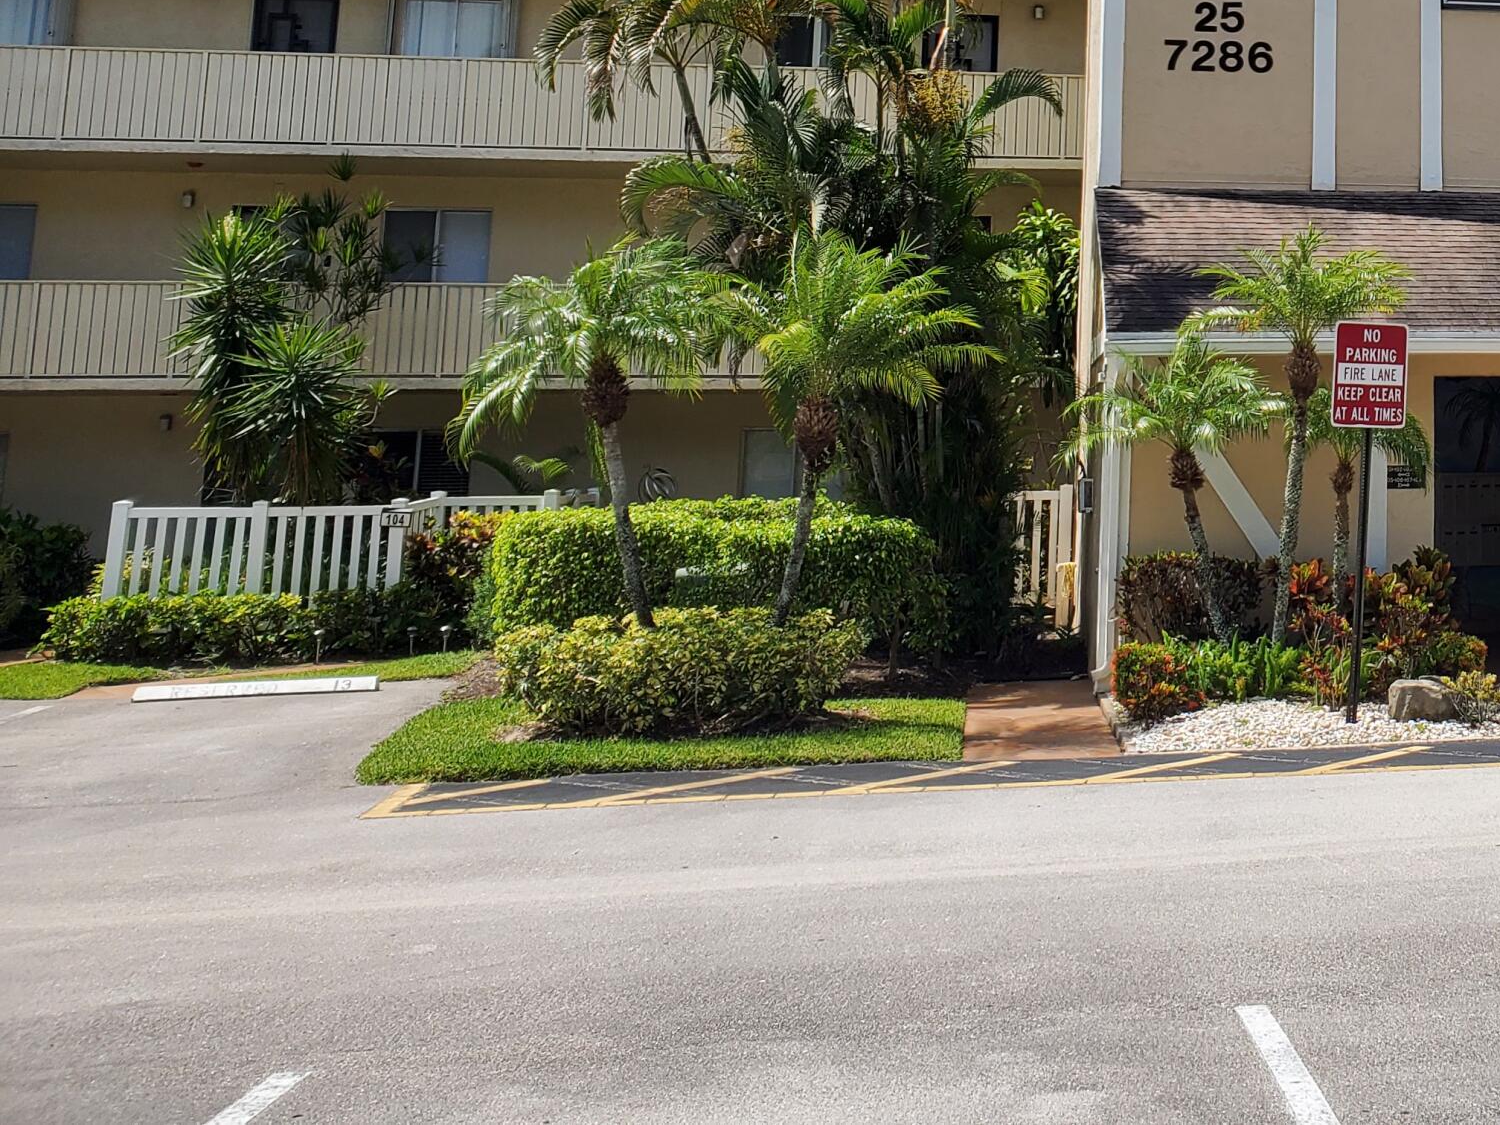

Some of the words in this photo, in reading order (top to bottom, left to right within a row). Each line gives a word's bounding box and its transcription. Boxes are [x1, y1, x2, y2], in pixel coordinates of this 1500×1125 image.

[1194, 1, 1245, 33] 25
[1164, 39, 1273, 73] 7286
[1363, 328, 1381, 343] NO
[1346, 347, 1397, 363] PARKING
[1344, 367, 1366, 381] FIRE
[1371, 368, 1397, 382] LANE
[1337, 386, 1364, 401] KEEP
[1369, 387, 1402, 402] CLEAR
[1334, 406, 1347, 421] AT
[1350, 407, 1370, 421] ALL
[1374, 407, 1402, 422] TIMES
[385, 514, 405, 526] 104
[333, 678, 352, 691] 13
